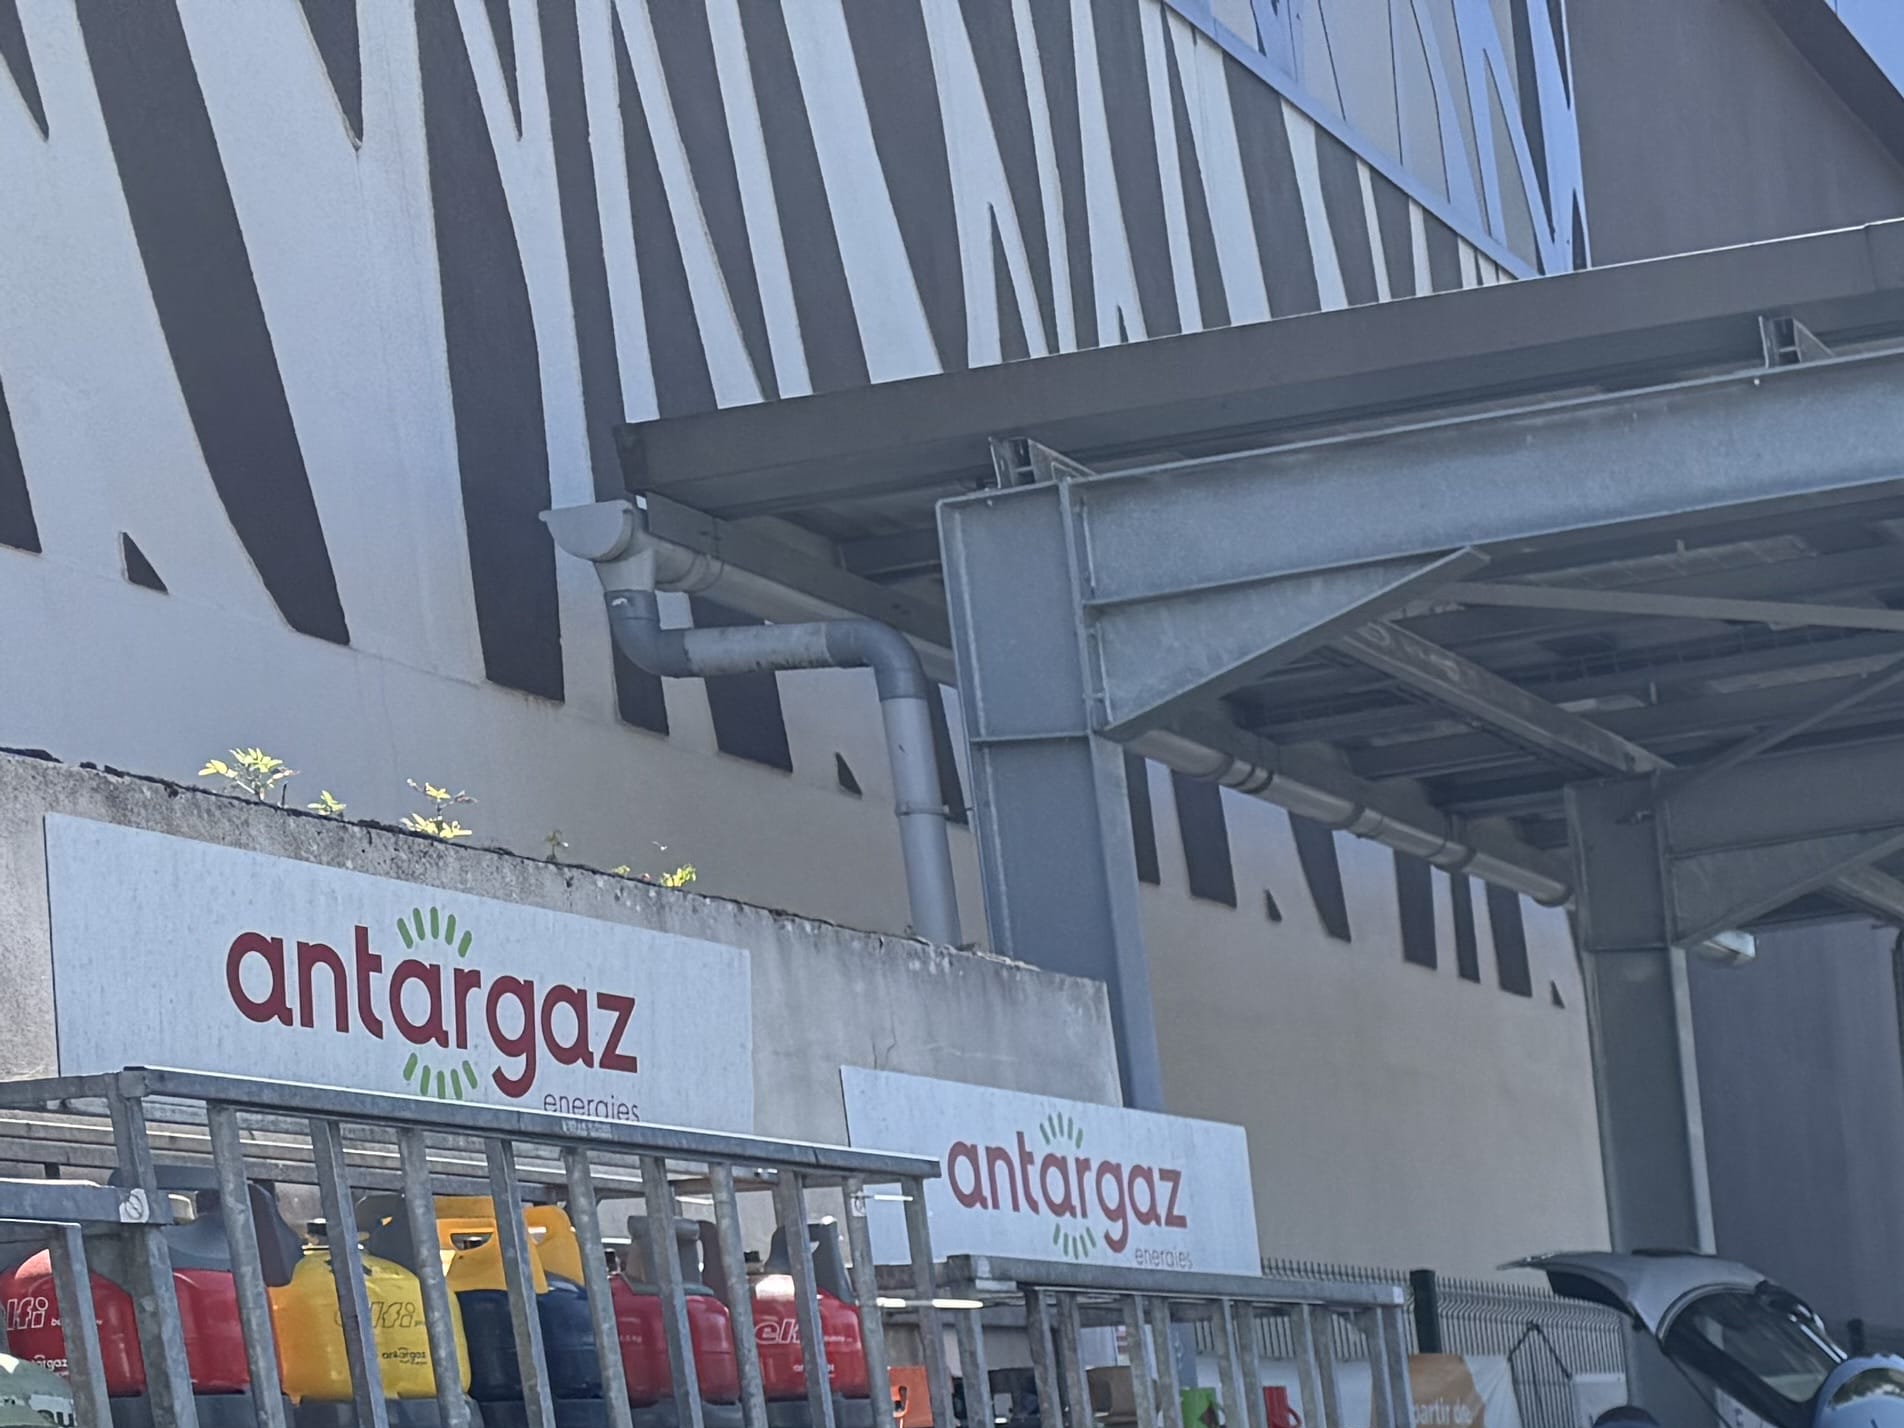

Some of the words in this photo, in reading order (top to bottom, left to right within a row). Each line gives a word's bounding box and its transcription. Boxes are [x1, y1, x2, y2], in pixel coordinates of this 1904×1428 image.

[226, 925, 638, 1098] antargaz
[543, 1094, 640, 1122] energies
[947, 1131, 1187, 1253] antargaz
[1135, 1246, 1193, 1269] energies
[0, 1297, 48, 1330] lfi
